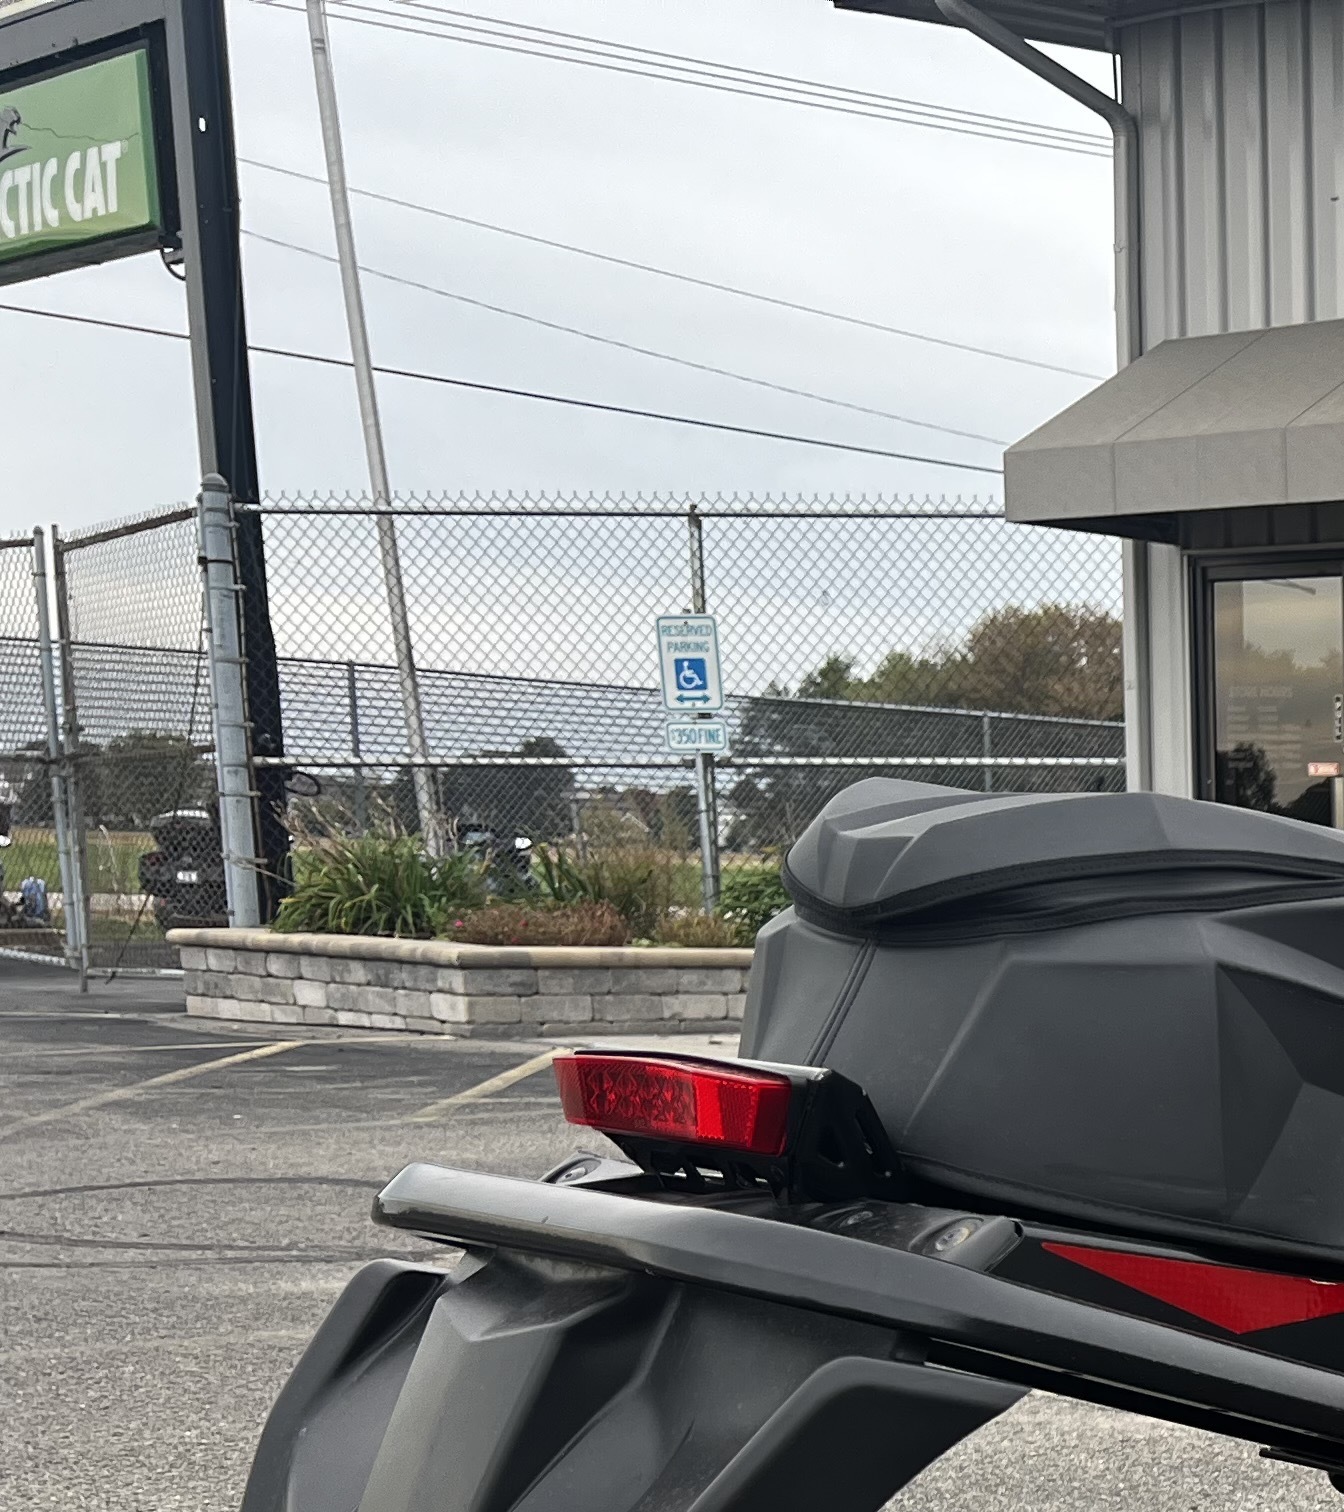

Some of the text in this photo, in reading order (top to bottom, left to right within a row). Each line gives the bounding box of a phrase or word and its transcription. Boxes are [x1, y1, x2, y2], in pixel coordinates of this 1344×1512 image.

[64, 140, 121, 222] CAT
[661, 624, 712, 637] RESERVED
[667, 641, 709, 653] PARKING
[698, 727, 722, 744] FINE
